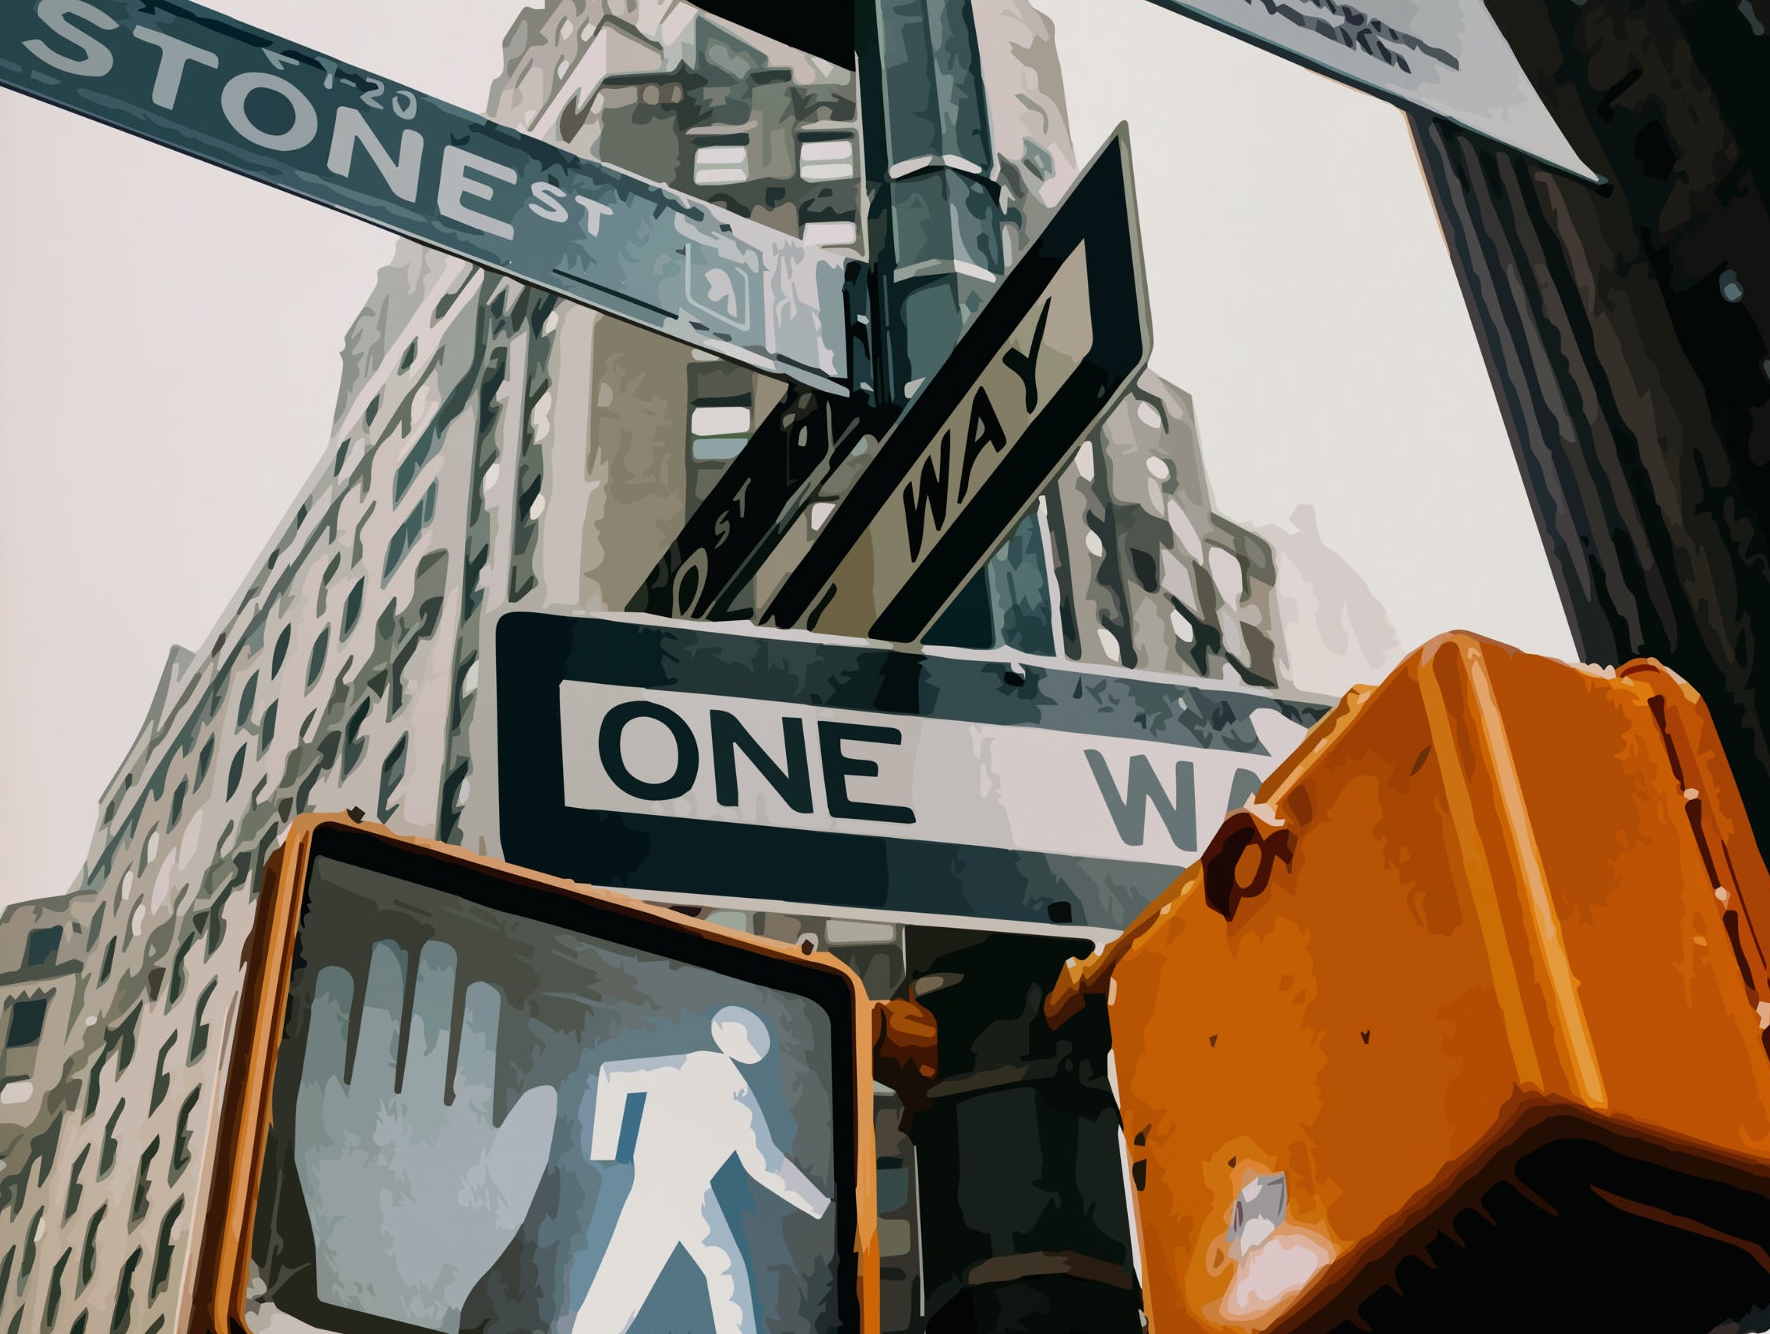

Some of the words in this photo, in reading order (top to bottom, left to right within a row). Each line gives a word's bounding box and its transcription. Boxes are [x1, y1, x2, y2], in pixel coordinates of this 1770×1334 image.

[529, 181, 614, 237] ST
[902, 295, 1052, 563] WAY
[598, 700, 916, 824] ONE
